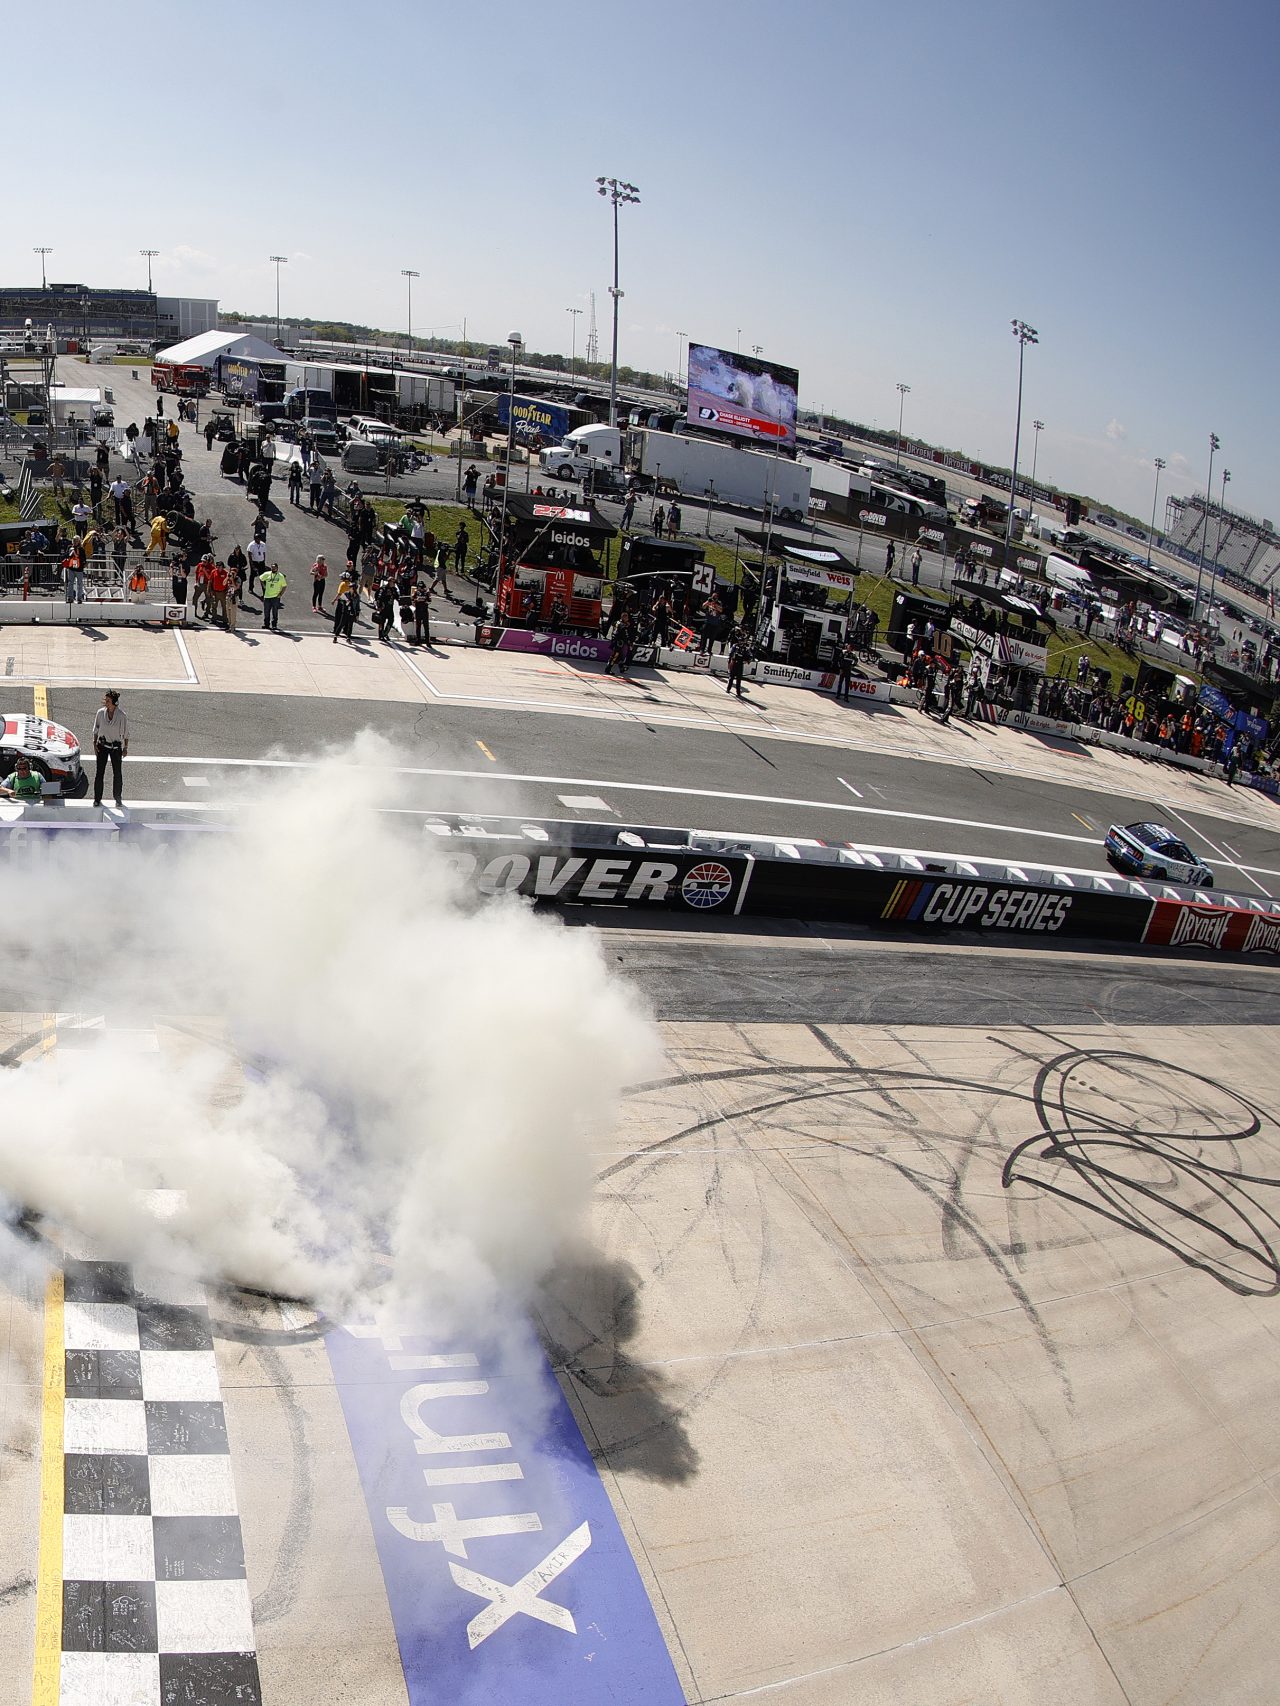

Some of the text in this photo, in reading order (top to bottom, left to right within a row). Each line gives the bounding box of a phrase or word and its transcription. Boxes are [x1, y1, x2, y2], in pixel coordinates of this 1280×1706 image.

[513, 405, 552, 425] OODYEAR
[700, 408, 711, 418] 9
[906, 442, 935, 460] DRYDENE
[551, 530, 590, 547] leidos
[693, 563, 713, 594] 23
[789, 565, 821, 577] Smithfield
[827, 573, 851, 586] weis
[169, 609, 184, 618] GT
[964, 626, 975, 637] ally
[551, 637, 598, 658] leidos
[934, 630, 952, 657] 10
[1009, 644, 1024, 657] ally
[632, 646, 653, 661] 23
[697, 658, 708, 667] GT
[764, 665, 811, 681] Smithfield
[818, 673, 836, 690] 10
[849, 679, 876, 694] weis
[998, 708, 1009, 719] 48
[1125, 696, 1145, 720] 48
[1014, 713, 1030, 728] ally
[1184, 868, 1202, 886] 34
[923, 884, 1072, 931] CUP SERIES
[1169, 906, 1233, 949] DRYDENE
[342, 1302, 591, 1650] xfinit
[537, 1552, 569, 1583] AMIR
